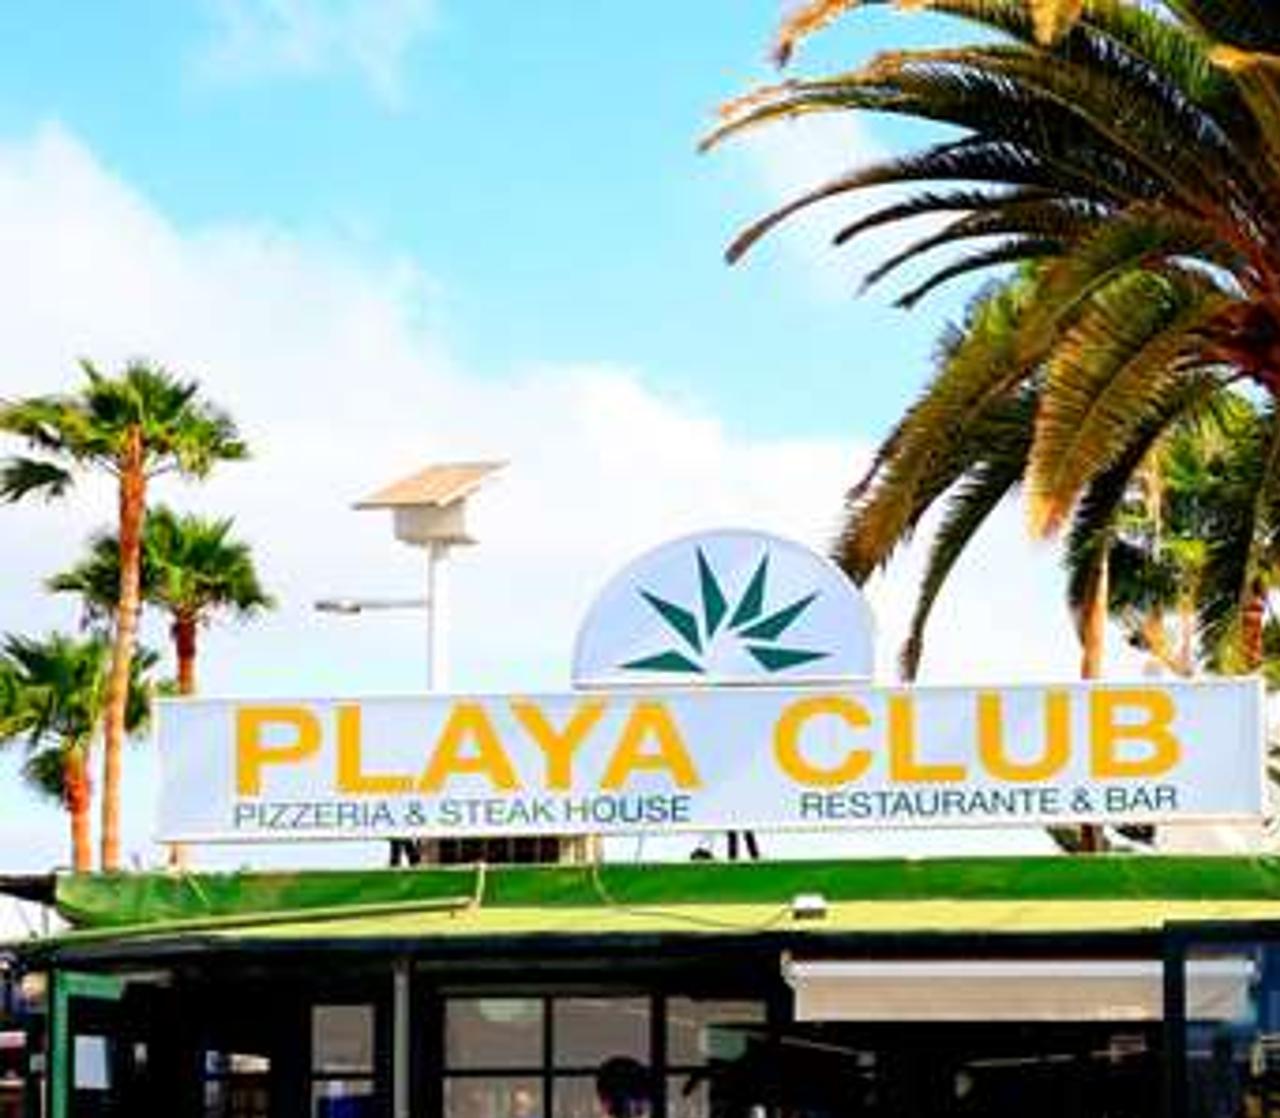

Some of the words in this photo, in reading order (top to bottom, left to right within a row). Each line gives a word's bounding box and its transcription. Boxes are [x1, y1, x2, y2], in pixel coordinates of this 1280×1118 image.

[234, 699, 702, 797] PLAYA
[771, 688, 1184, 784] CLUB
[234, 802, 395, 828] PIZZERIA
[404, 802, 427, 826] &
[438, 799, 555, 824] STEAK
[563, 795, 691, 822] HOUSE
[801, 788, 1061, 818] RESTAURANTE
[1070, 788, 1095, 812] &
[1105, 786, 1178, 811] BAR
